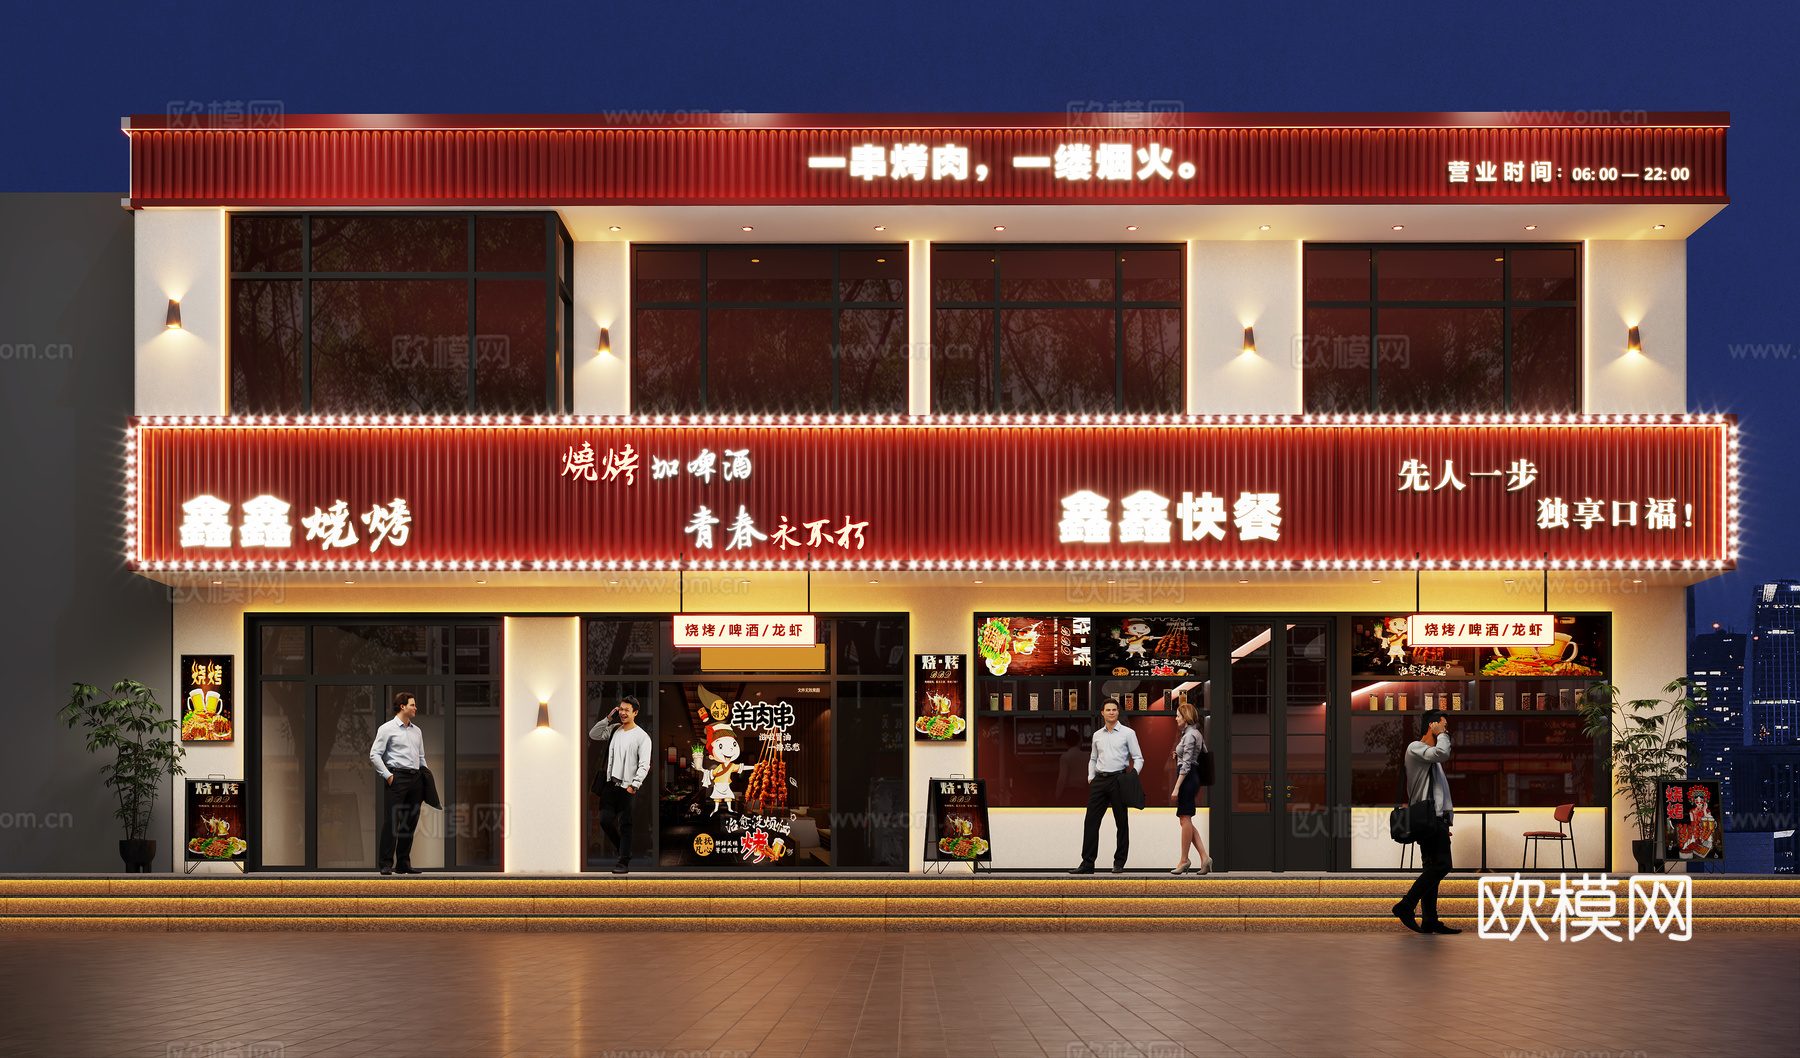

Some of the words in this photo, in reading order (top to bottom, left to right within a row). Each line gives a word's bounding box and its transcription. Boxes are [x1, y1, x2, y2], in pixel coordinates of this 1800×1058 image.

[1398, 459, 1538, 492] 先人一步
[1057, 489, 1283, 543] 鑫鑫快餐
[684, 622, 804, 637] 烧烤/啤酒/龙虾
[1424, 622, 1544, 637] 烧烤/啤酒/龙虾
[191, 658, 223, 686] 烧烤
[731, 700, 796, 732] 羊肉串
[1665, 784, 1684, 820] 烧烤
[741, 828, 769, 863] 烤
